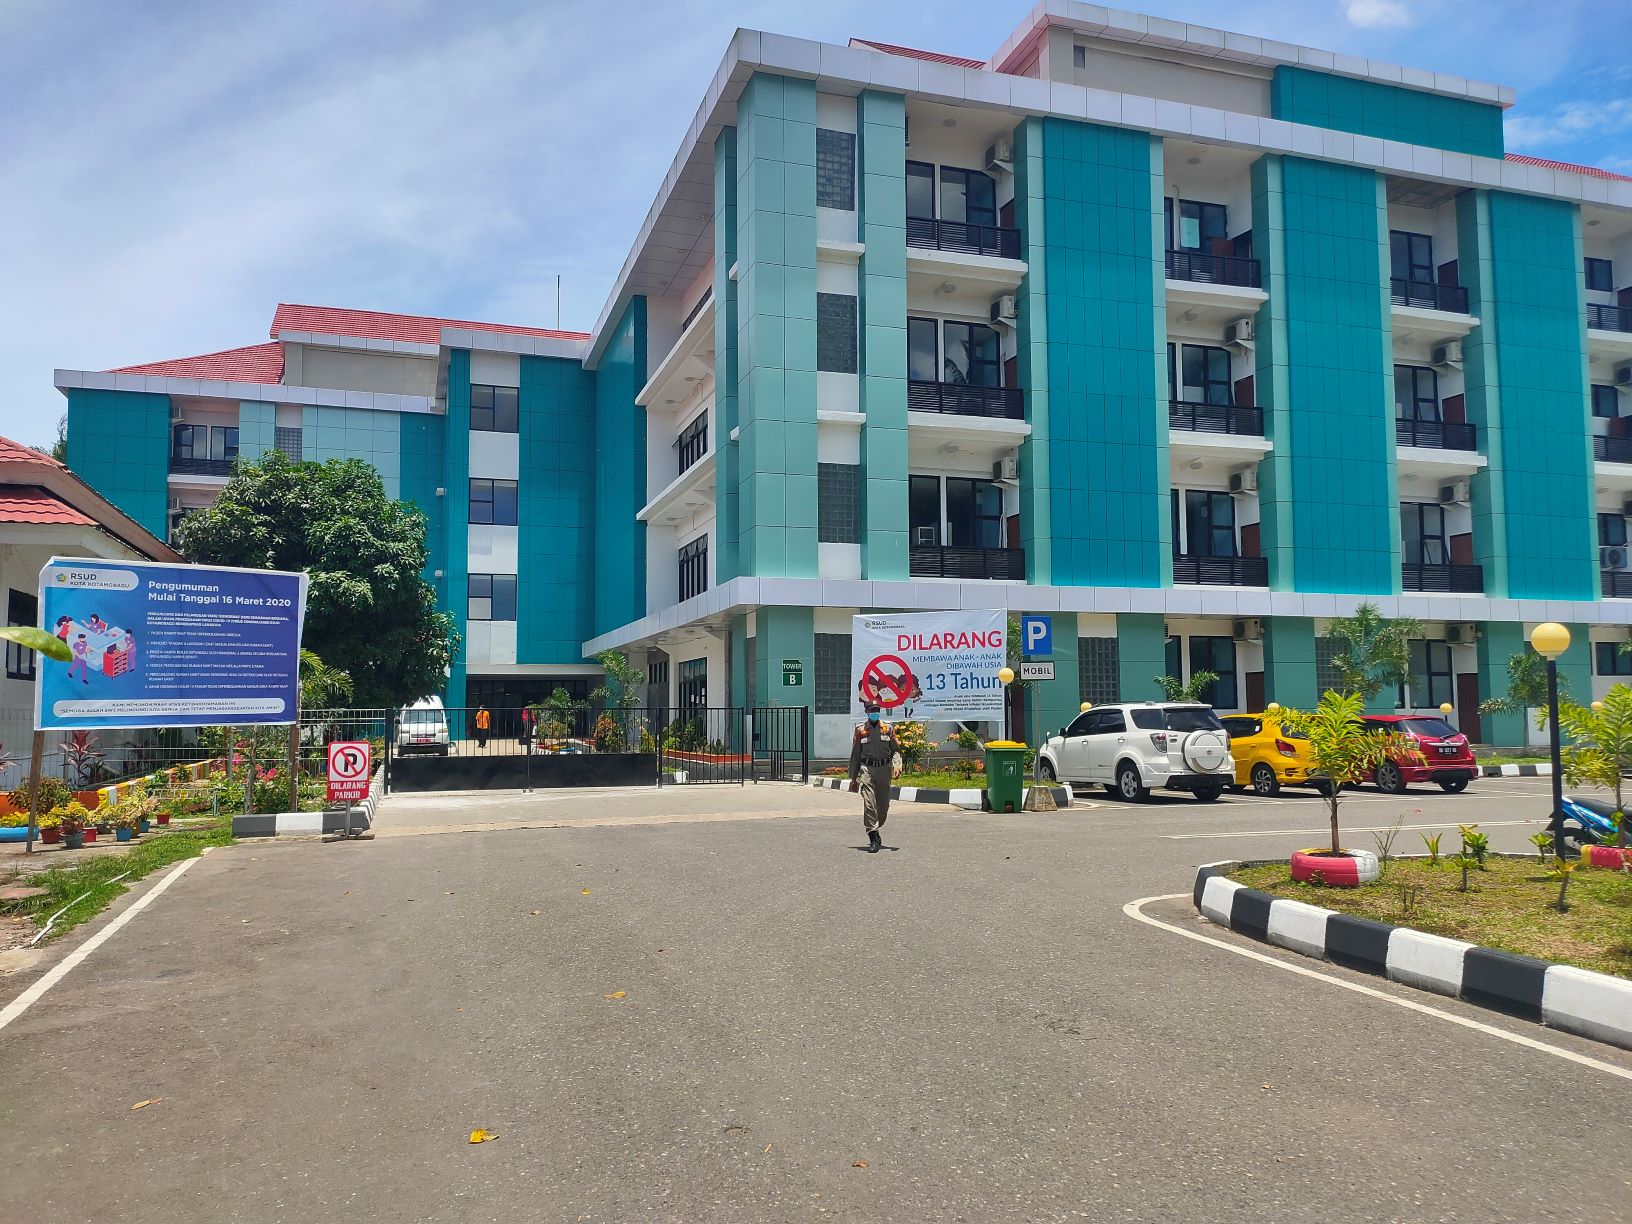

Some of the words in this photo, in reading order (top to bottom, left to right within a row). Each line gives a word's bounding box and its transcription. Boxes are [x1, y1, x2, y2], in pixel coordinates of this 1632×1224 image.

[149, 581, 219, 592] Pengumuman
[148, 593, 176, 601] Mulai
[179, 594, 219, 604] Tanggal
[222, 596, 232, 604] 16
[236, 597, 263, 605] Maret
[266, 599, 291, 607] 2020
[898, 631, 1002, 651] DILARANG
[1028, 621, 1046, 650] P
[1023, 667, 1052, 675] MOBIL
[790, 674, 796, 685] B
[926, 673, 946, 690] 13
[950, 672, 1002, 690] Tahun
[330, 781, 366, 790] DILARANG
[334, 791, 360, 799] PARKIR
